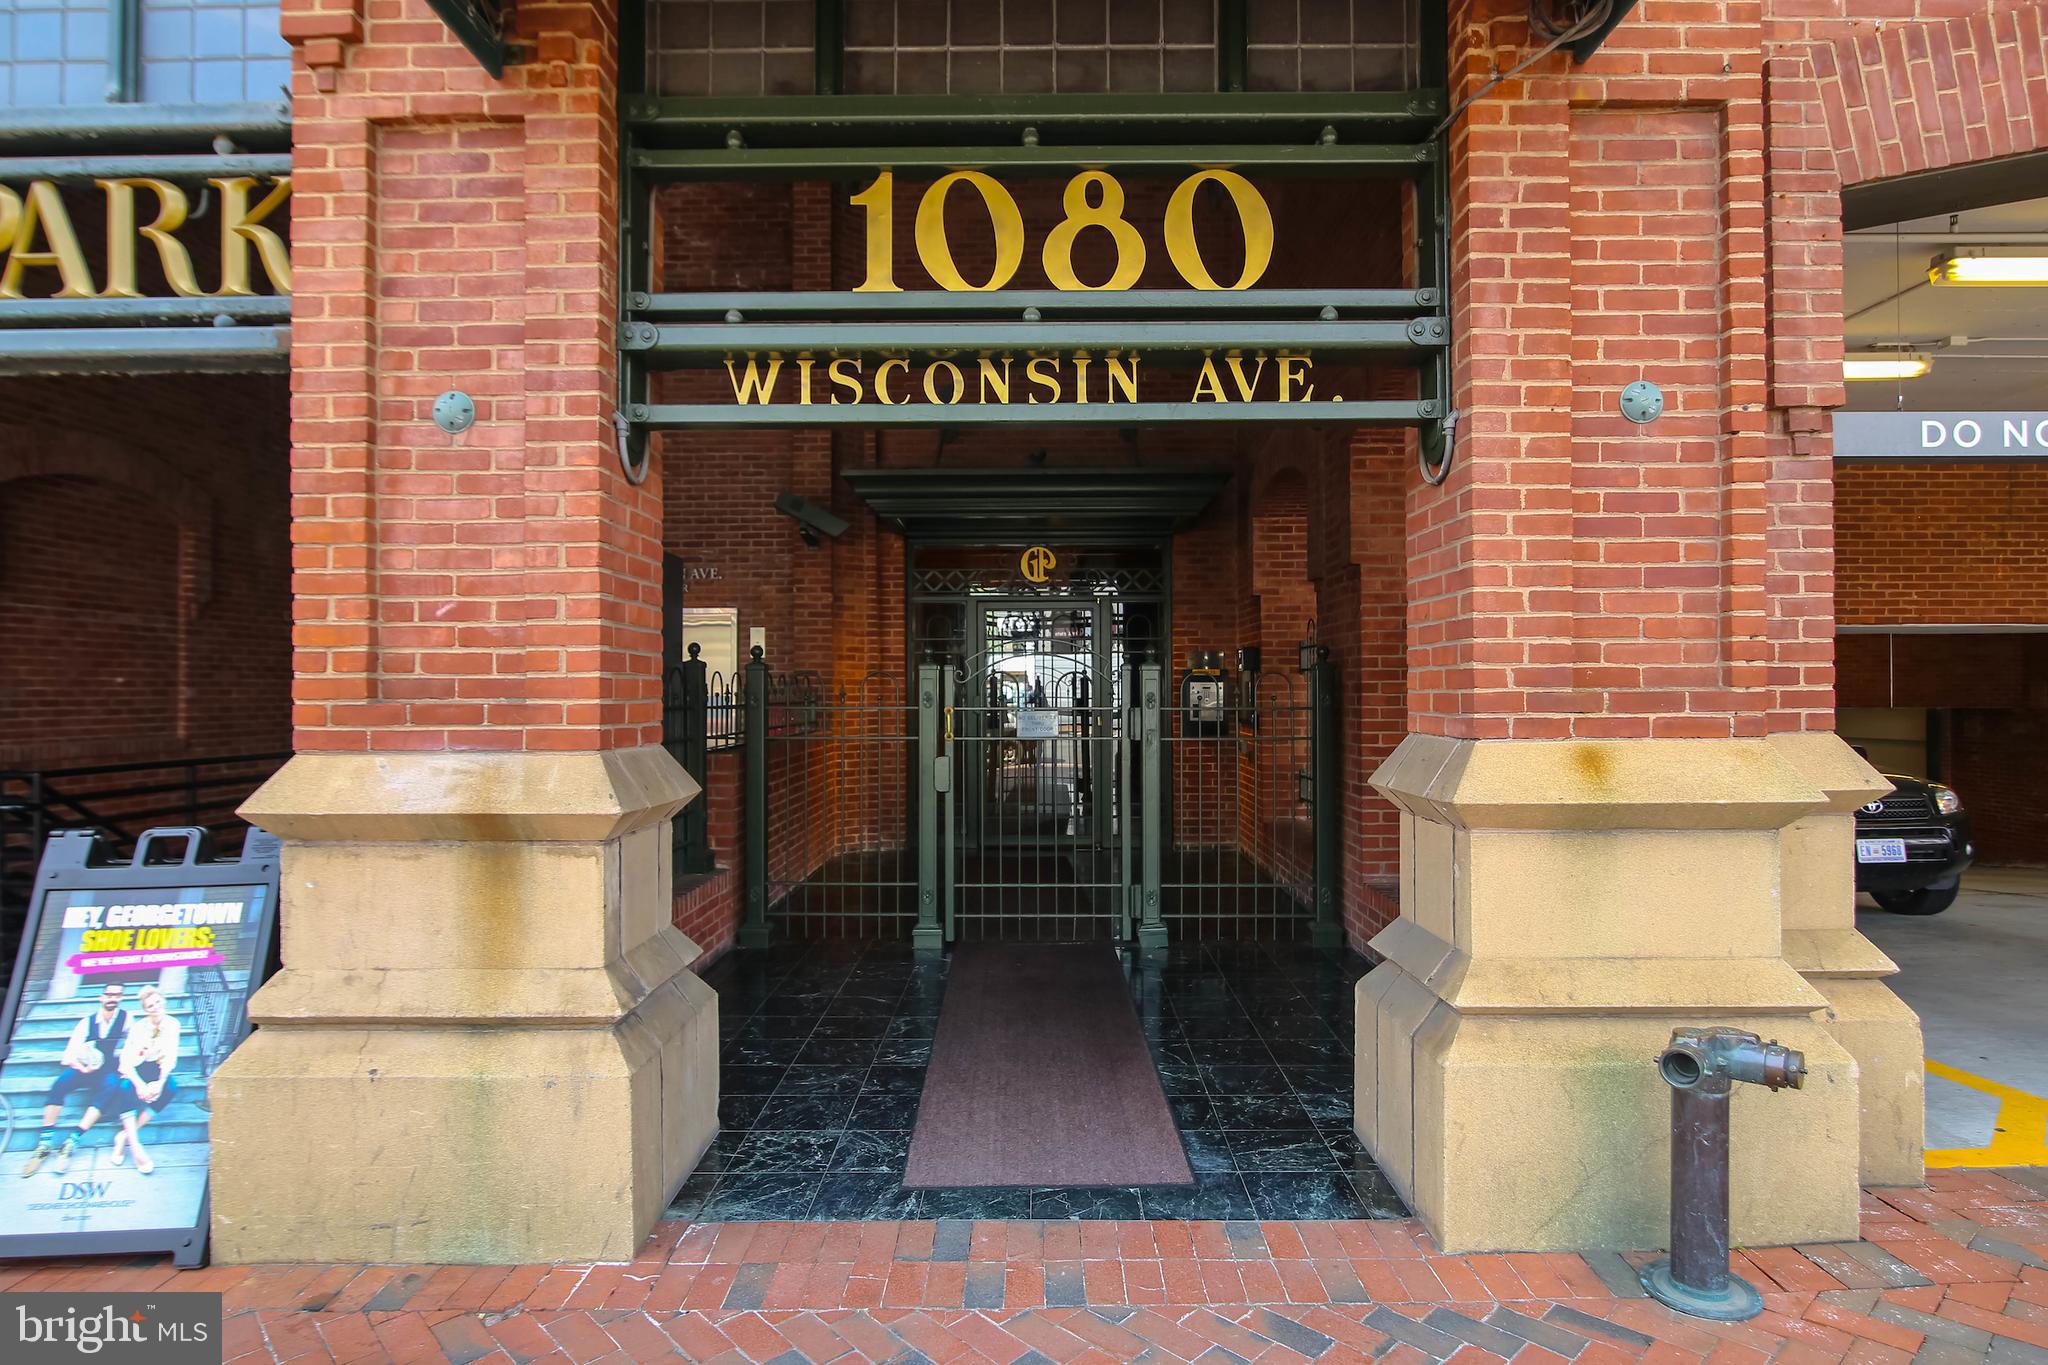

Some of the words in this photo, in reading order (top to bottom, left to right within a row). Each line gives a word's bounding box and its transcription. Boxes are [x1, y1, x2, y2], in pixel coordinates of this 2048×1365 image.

[0, 176, 291, 298] ARK
[850, 169, 1275, 292] 1080
[722, 357, 1139, 405] WISCONSIN
[1191, 357, 1343, 404] AVE.
[1921, 419, 1982, 448] DO
[691, 567, 722, 580] AVE.
[105, 902, 244, 928] GEORGETOWN
[79, 929, 135, 952] SHOE
[58, 1181, 113, 1200] DSW
